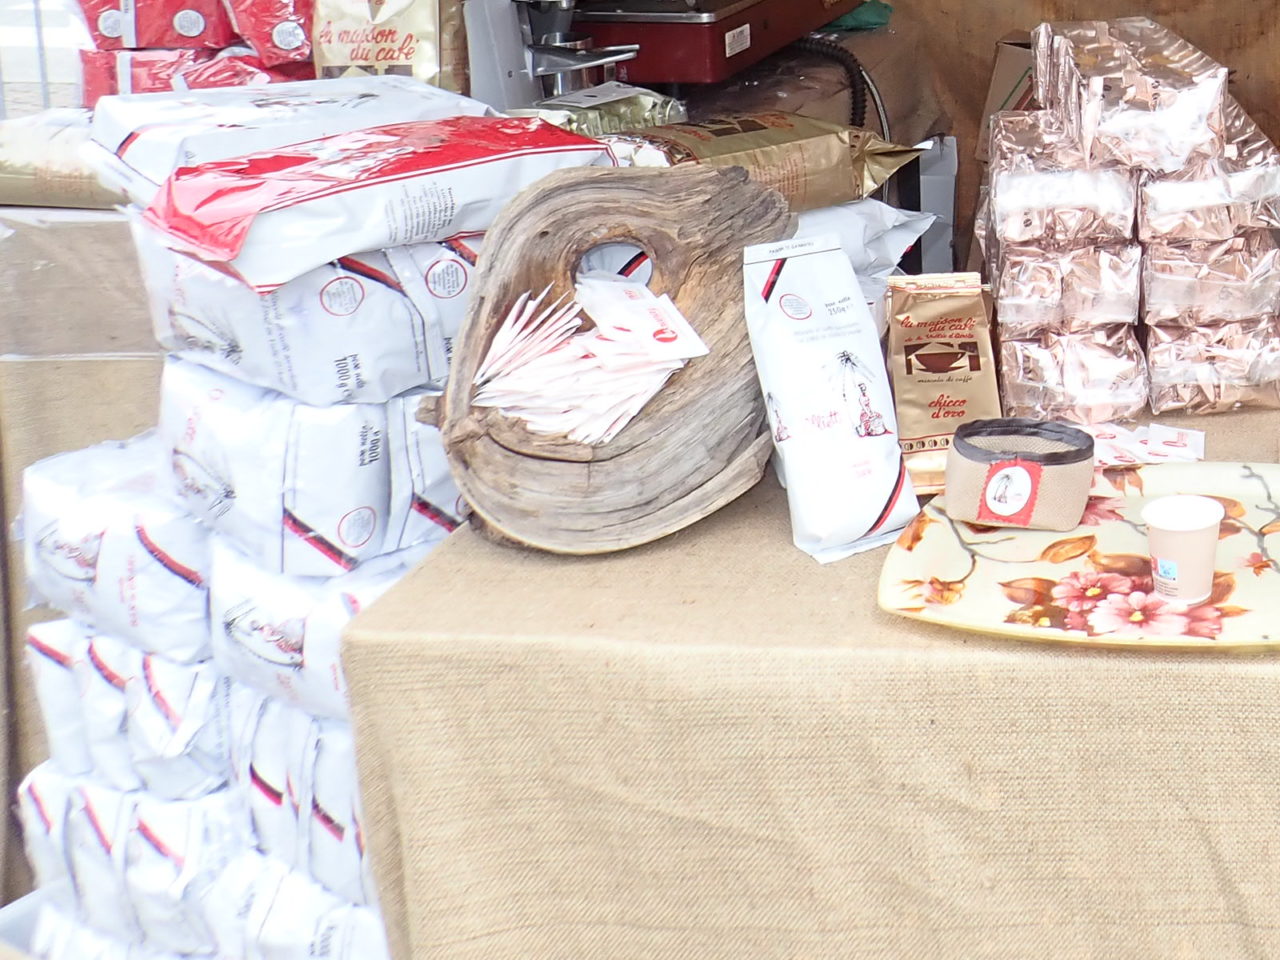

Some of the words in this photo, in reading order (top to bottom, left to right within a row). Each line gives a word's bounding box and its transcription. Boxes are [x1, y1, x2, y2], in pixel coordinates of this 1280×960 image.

[350, 44, 370, 61] du
[916, 316, 963, 328] maison
[928, 324, 946, 333] du
[333, 356, 350, 382] 1000
[927, 392, 967, 410] chicco
[930, 406, 966, 419] d'oro
[367, 435, 381, 465] 1000
